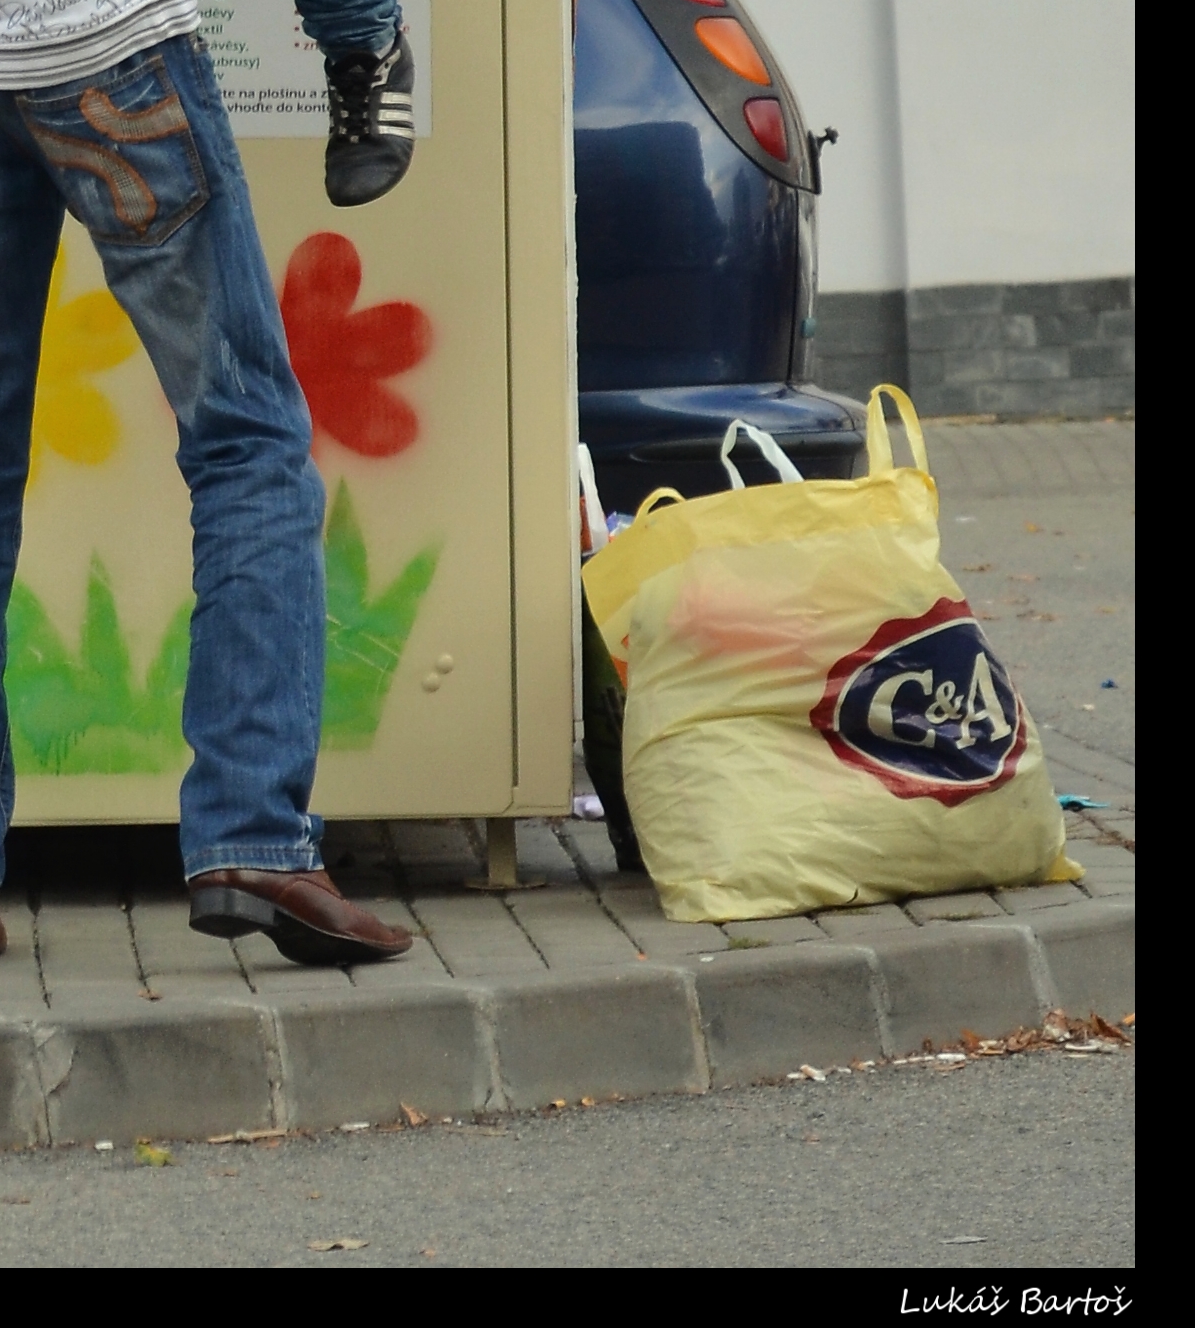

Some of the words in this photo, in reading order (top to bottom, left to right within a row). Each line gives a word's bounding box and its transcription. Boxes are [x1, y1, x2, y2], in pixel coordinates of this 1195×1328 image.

[239, 90, 255, 99] na
[258, 88, 306, 102] plošinu
[309, 90, 317, 99] a
[276, 102, 293, 113] do
[868, 651, 1012, 750] C&A
